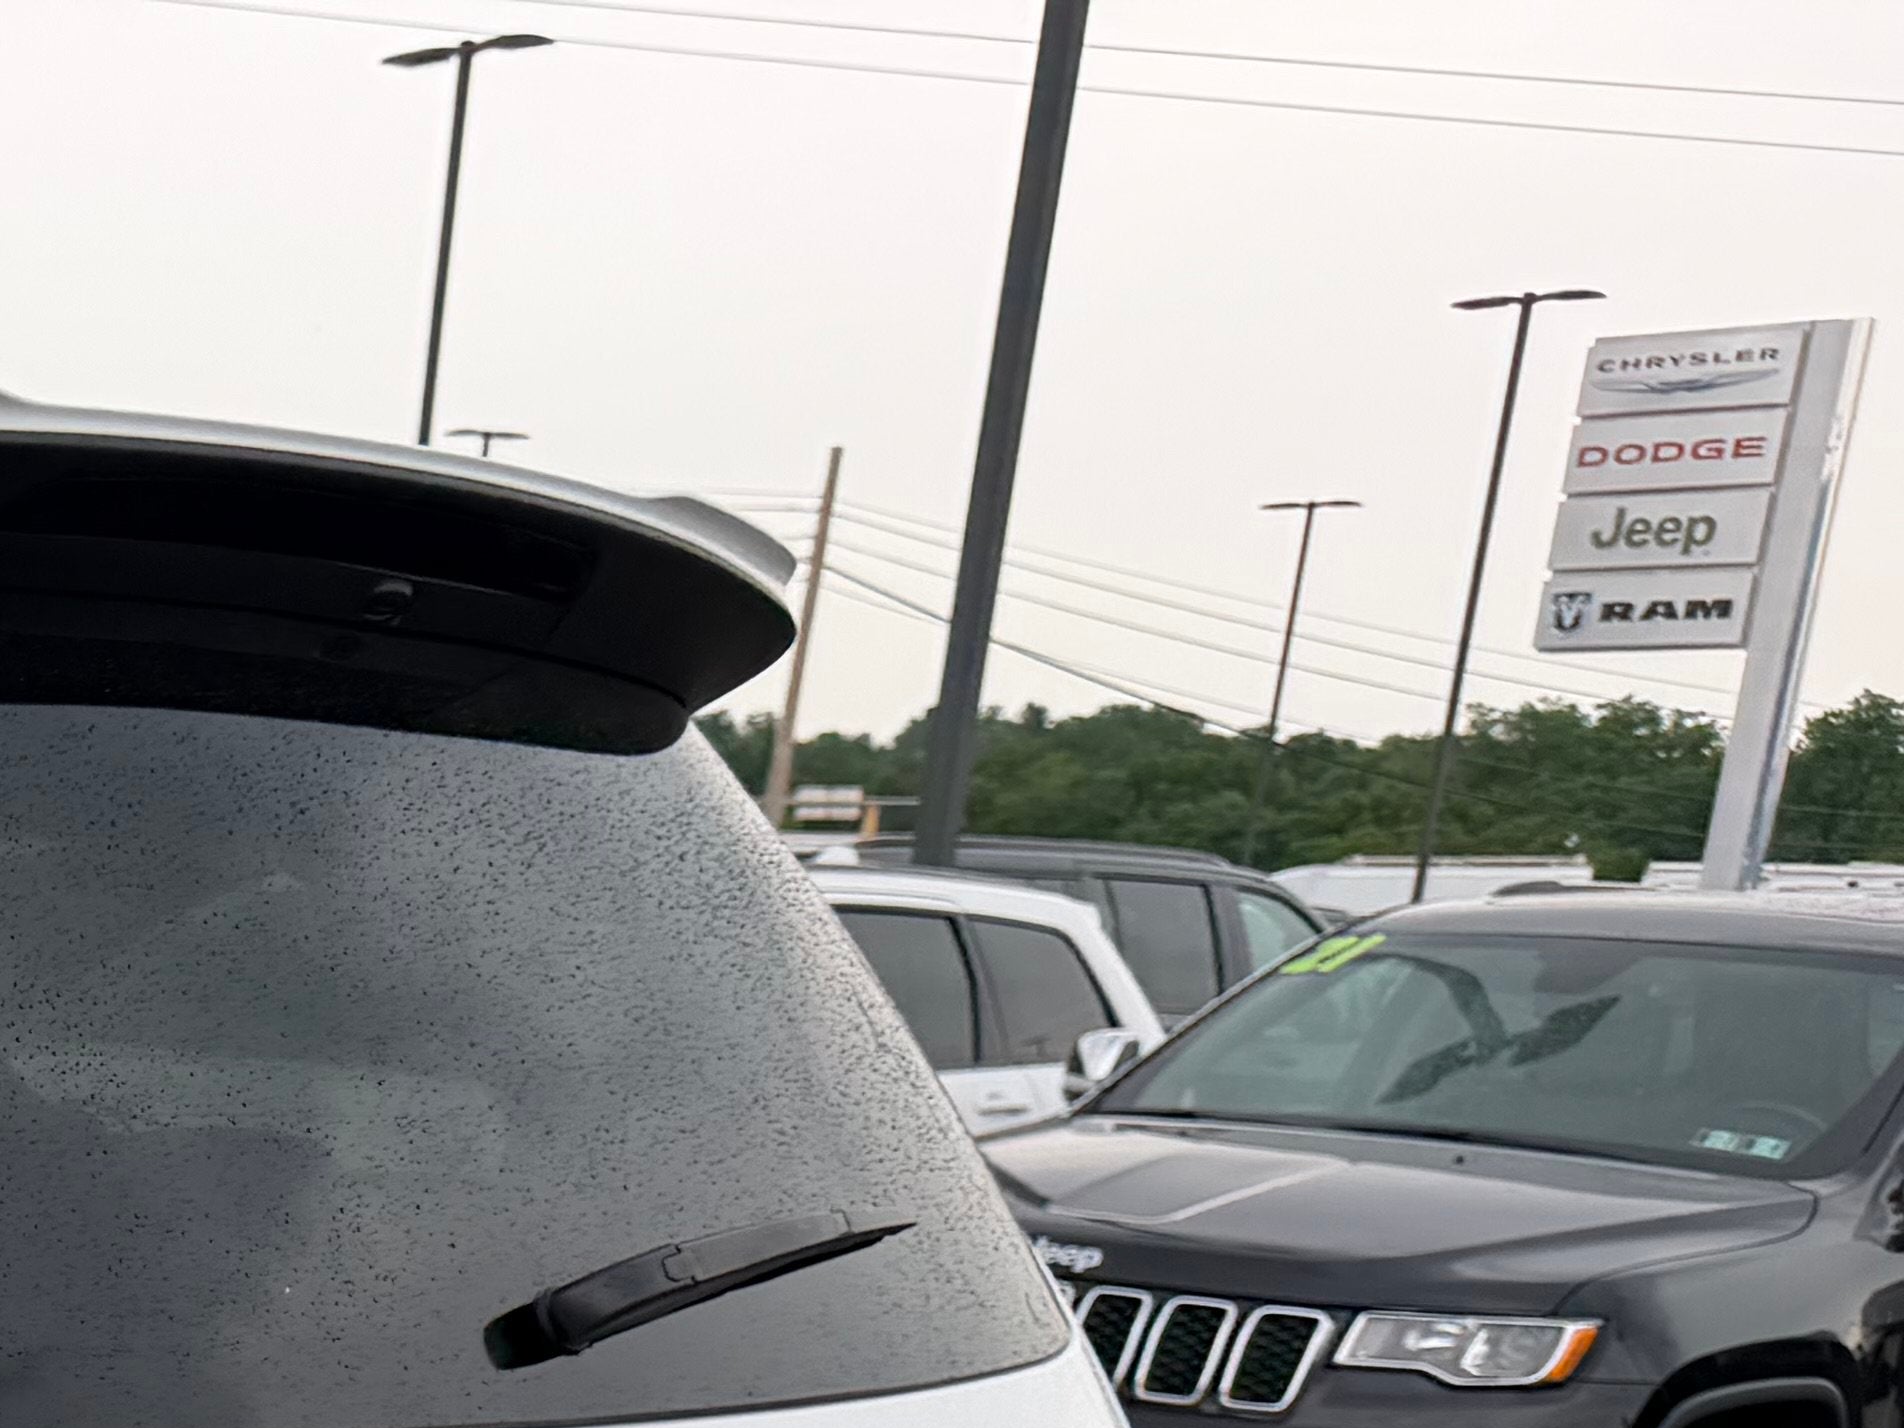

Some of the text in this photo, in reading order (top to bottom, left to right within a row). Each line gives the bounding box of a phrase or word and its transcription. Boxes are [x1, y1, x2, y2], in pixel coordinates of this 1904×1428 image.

[1597, 347, 1780, 373] CHRYSLER
[1577, 436, 1768, 468] DODGE
[1591, 506, 1717, 556] Jeep
[1598, 599, 1734, 622] RAM
